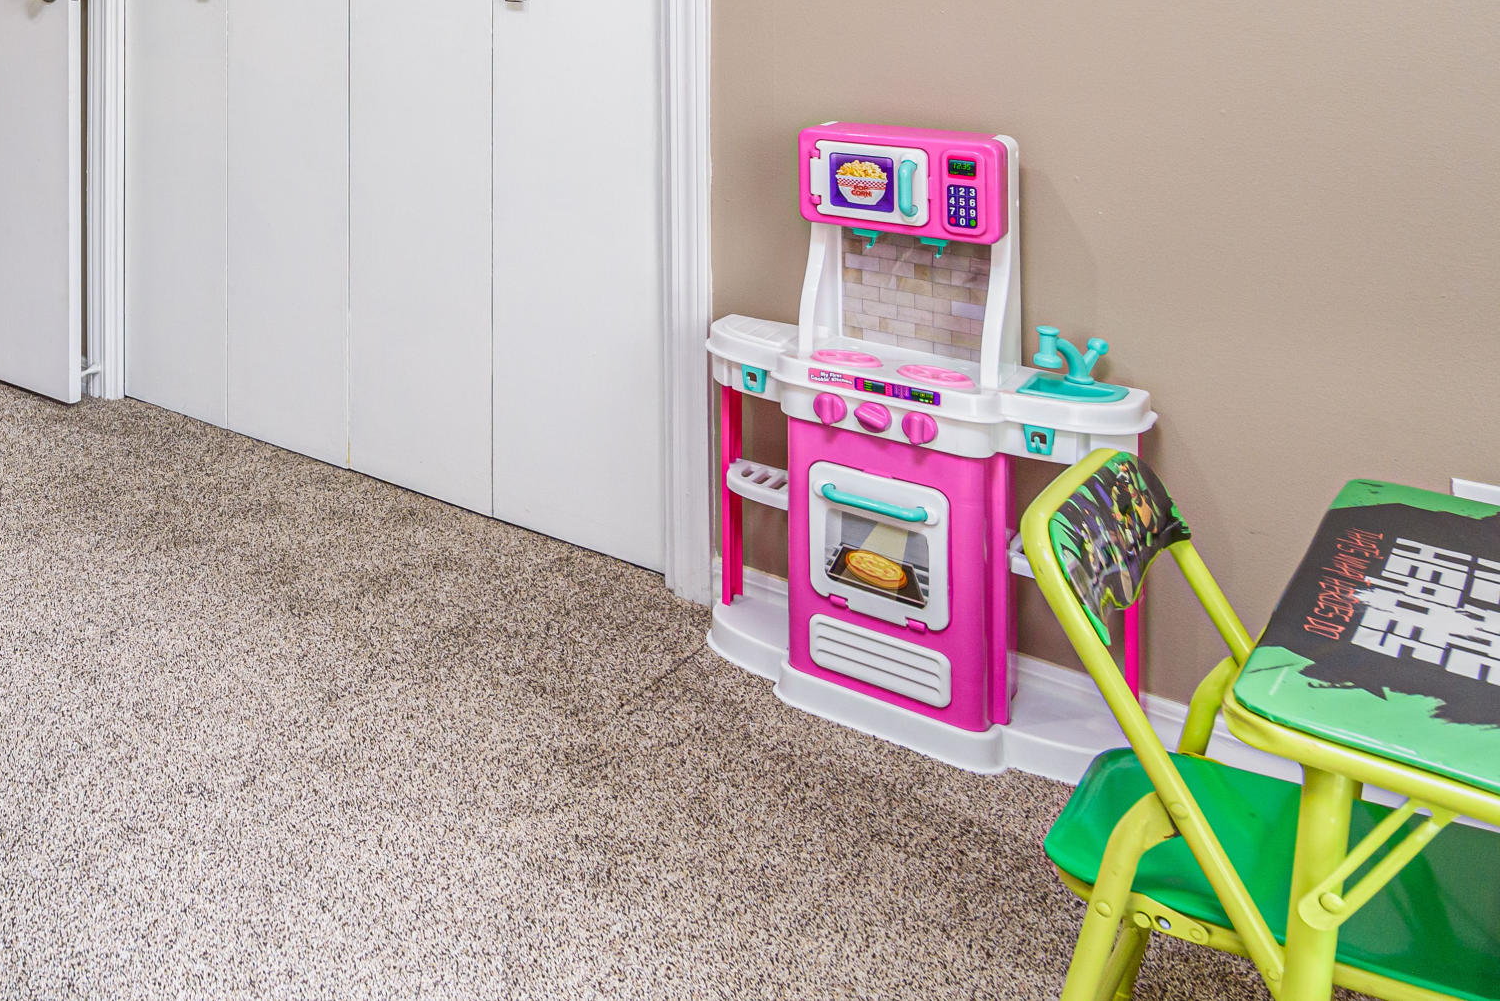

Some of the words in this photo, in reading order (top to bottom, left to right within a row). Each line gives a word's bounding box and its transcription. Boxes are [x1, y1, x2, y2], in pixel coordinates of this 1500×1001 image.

[851, 189, 872, 197] CORN
[949, 186, 954, 194] 1
[959, 187, 965, 196] 2
[969, 188, 976, 197] 3
[949, 197, 955, 205] 4
[959, 198, 965, 206] 5
[969, 199, 976, 207] 6
[949, 207, 955, 215] 7
[959, 208, 966, 216] 8
[970, 209, 976, 217] 9
[960, 217, 966, 226] 0
[1350, 537, 1474, 665] HEROES
[1303, 615, 1347, 641] DO
